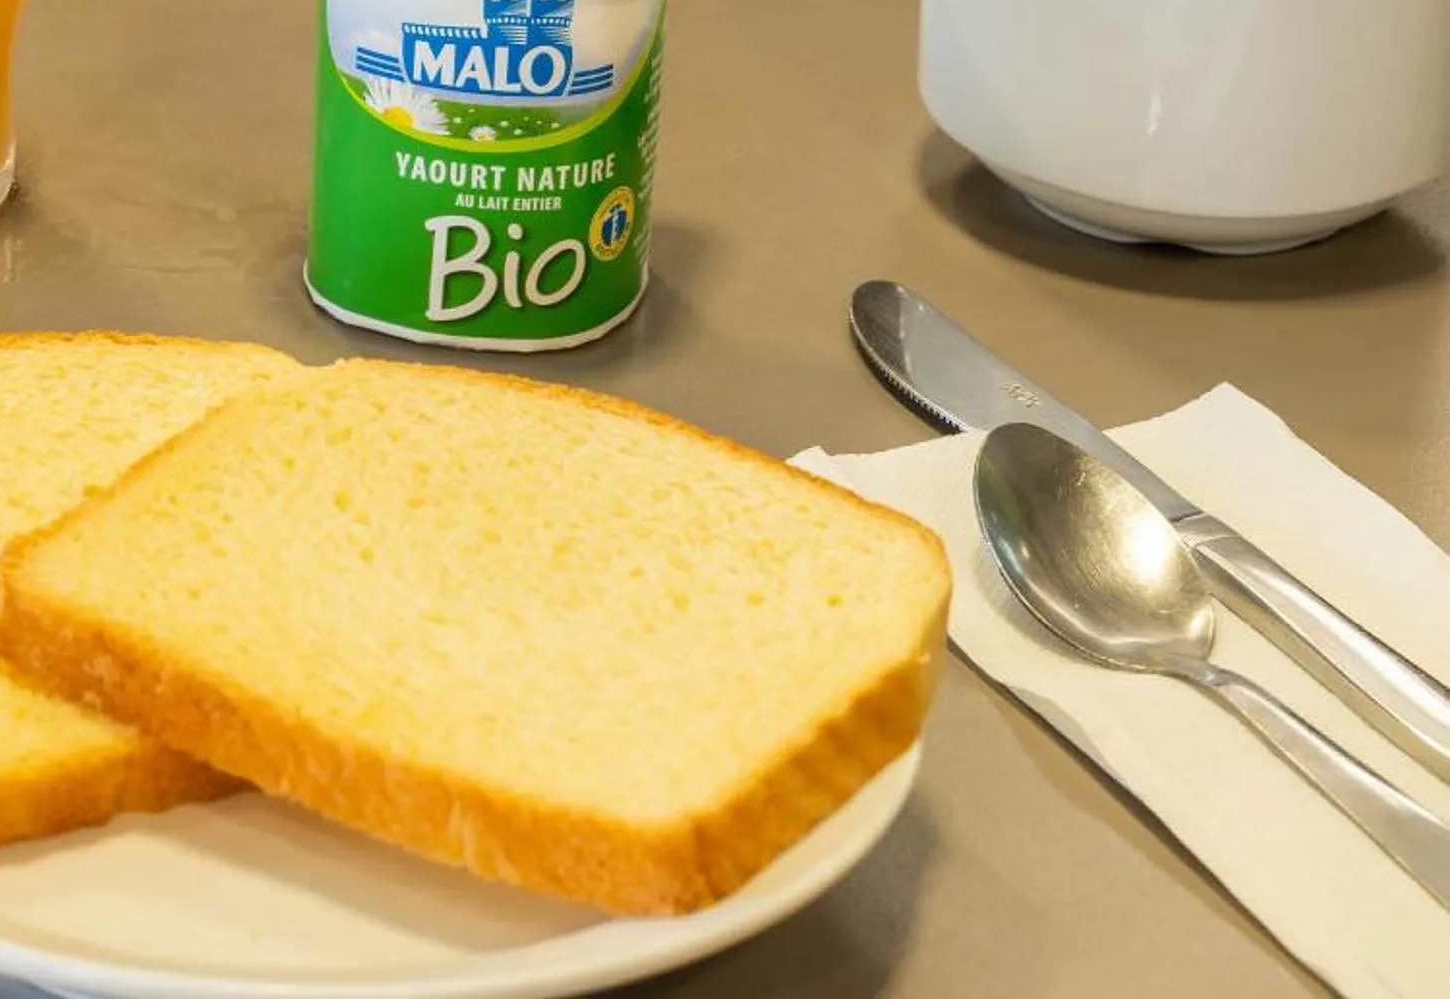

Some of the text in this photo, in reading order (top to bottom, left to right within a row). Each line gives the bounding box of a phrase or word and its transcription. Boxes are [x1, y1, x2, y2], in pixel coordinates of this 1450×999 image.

[412, 41, 566, 95] MALO
[395, 151, 617, 192] YAOURT NATURE
[454, 193, 562, 212] AU LAIT ENTIER
[424, 214, 586, 322] Bio
